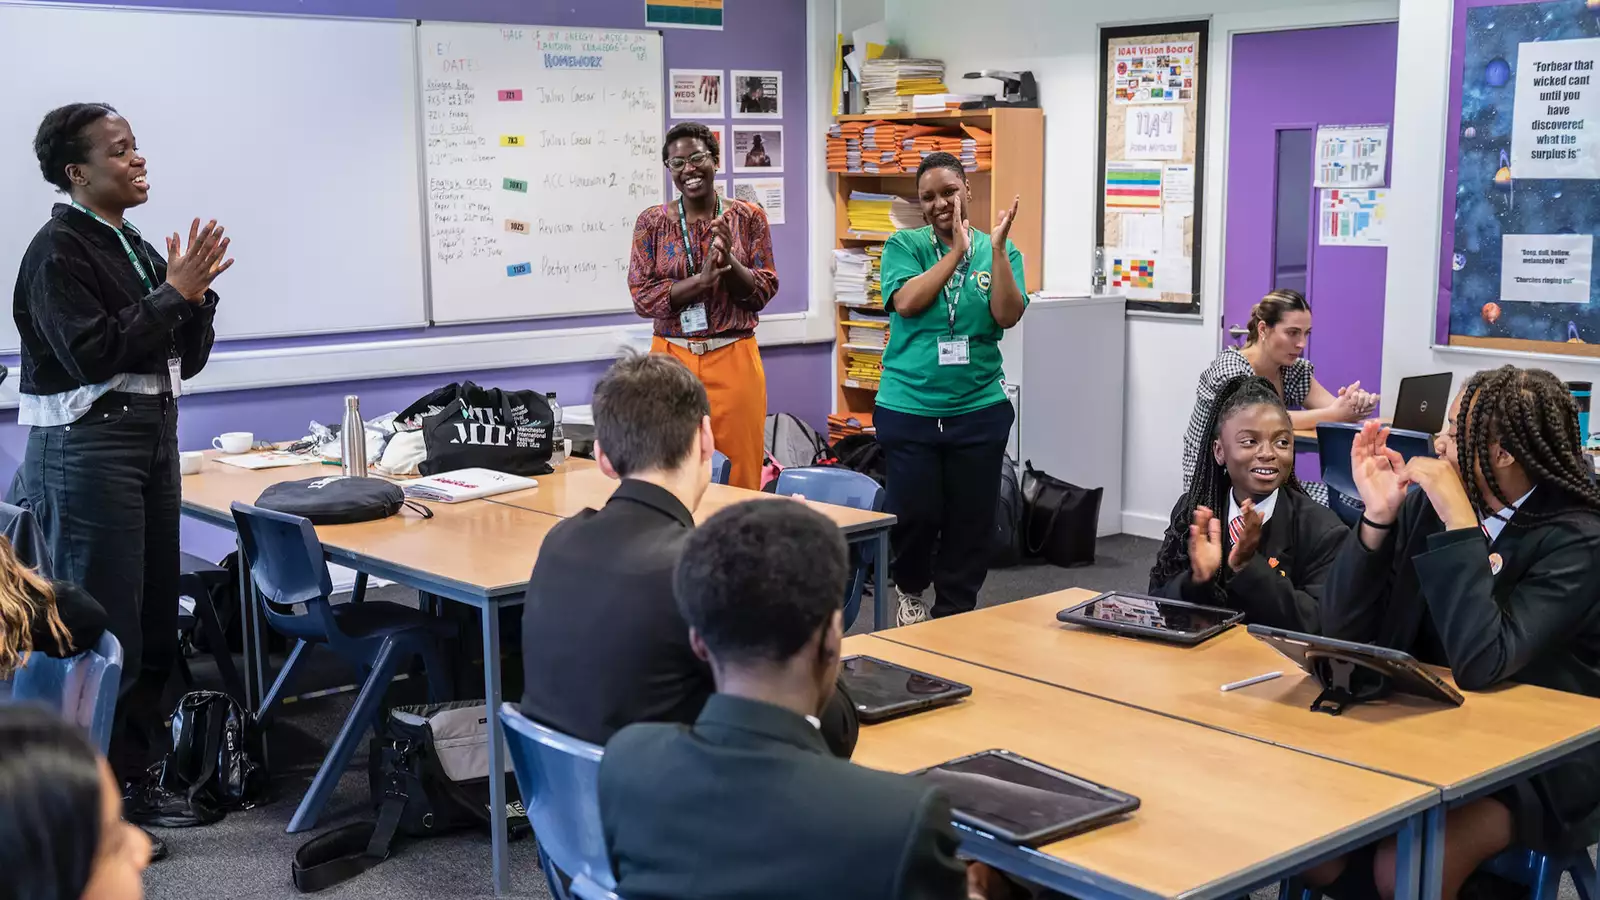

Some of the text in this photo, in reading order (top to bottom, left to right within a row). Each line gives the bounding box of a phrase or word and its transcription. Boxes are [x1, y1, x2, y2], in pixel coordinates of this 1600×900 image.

[1138, 46, 1164, 55] Vision
[1166, 45, 1194, 54] Board
[543, 53, 603, 69] HOMEWORK
[1574, 60, 1594, 70] that
[1533, 75, 1590, 87] wicked cant
[536, 86, 565, 105] Julius
[570, 85, 596, 102] Caesar
[1540, 90, 1580, 102] until you
[1547, 104, 1570, 115] have
[1531, 119, 1584, 130] discovered
[539, 130, 567, 148] Julius
[1536, 134, 1577, 145] what the
[1531, 148, 1567, 160] surplus
[538, 217, 575, 235] Revision
